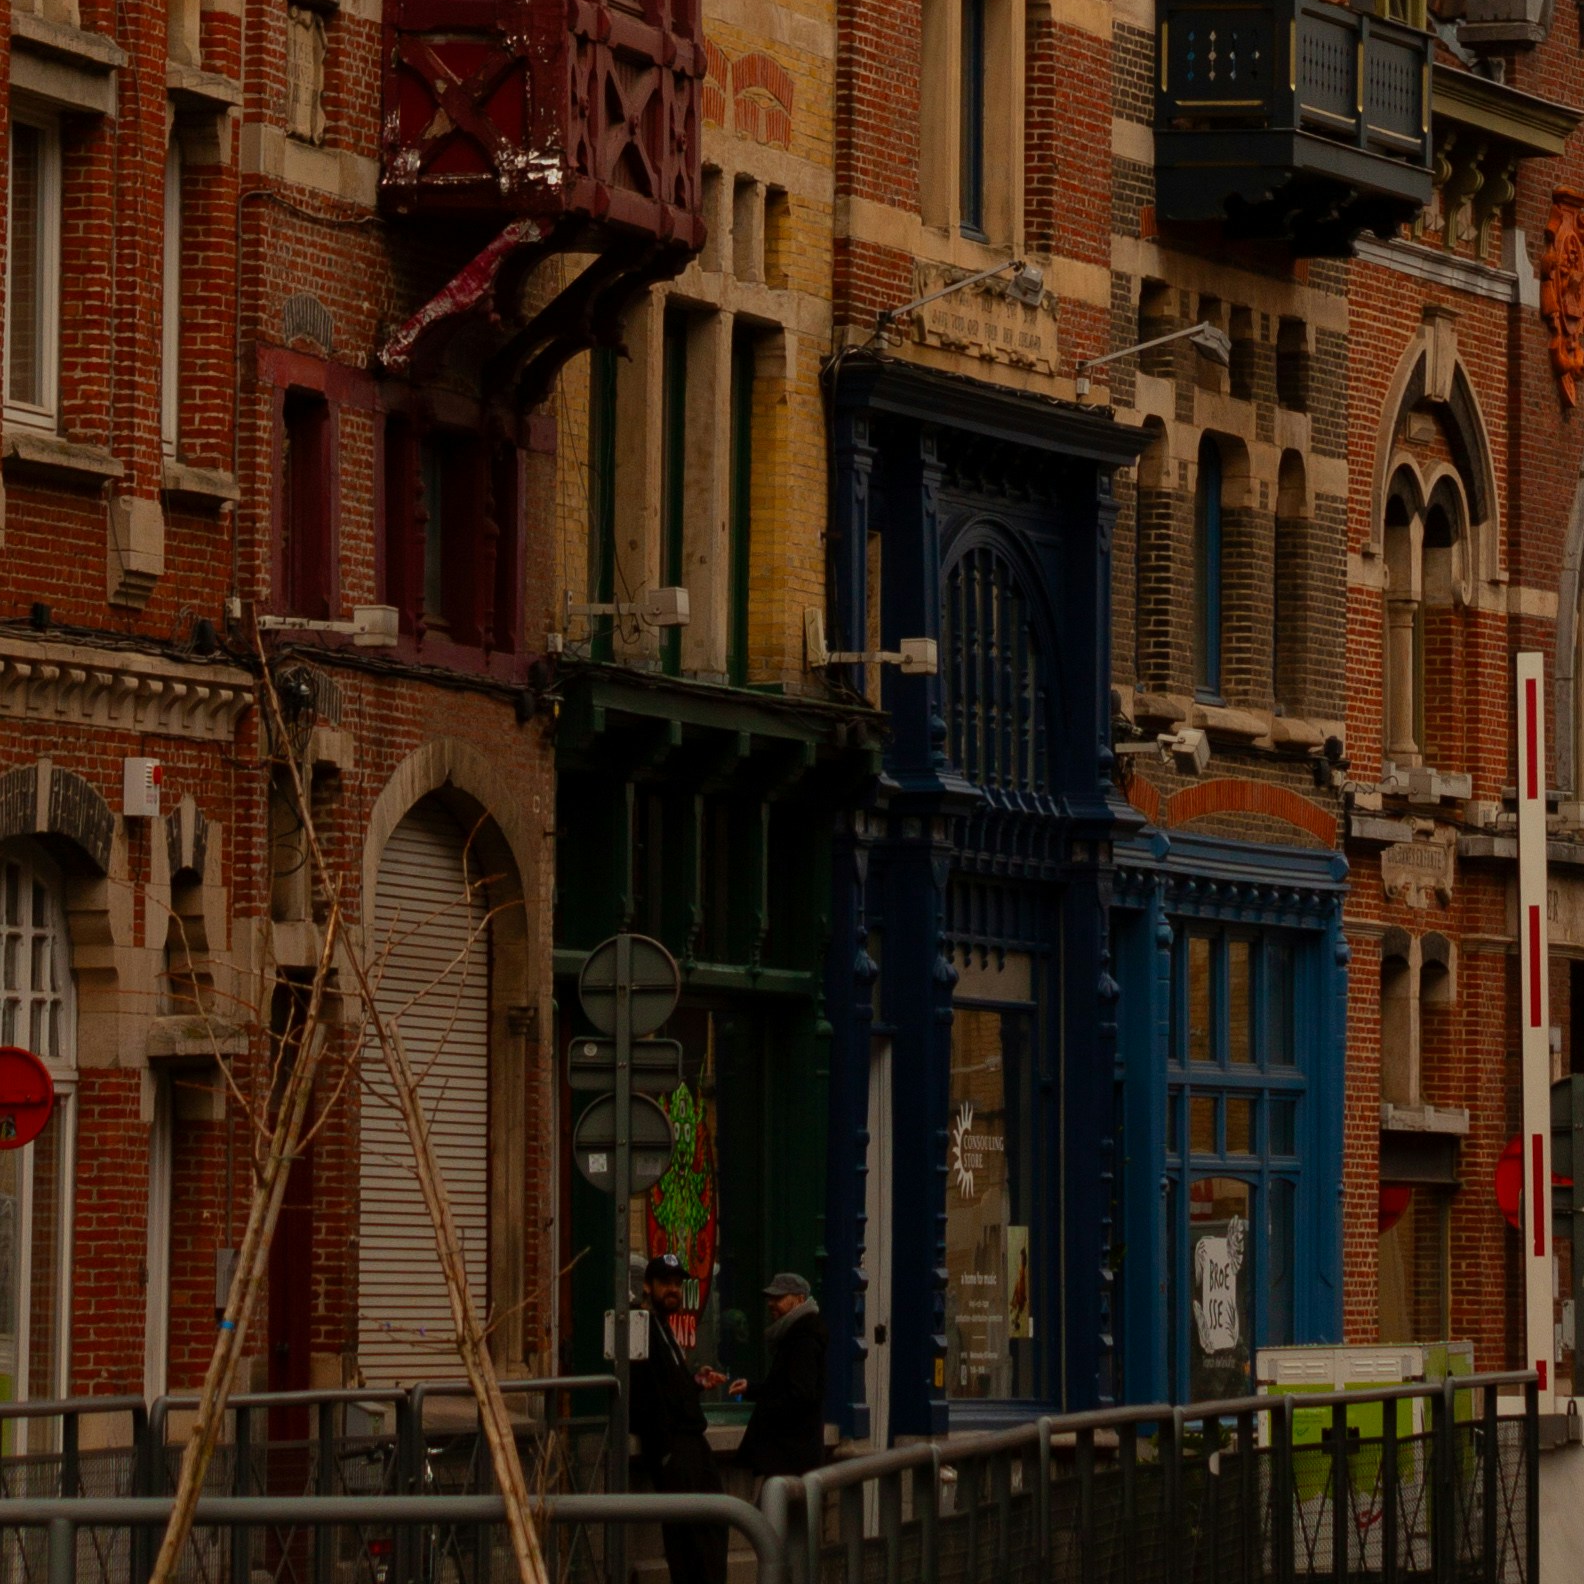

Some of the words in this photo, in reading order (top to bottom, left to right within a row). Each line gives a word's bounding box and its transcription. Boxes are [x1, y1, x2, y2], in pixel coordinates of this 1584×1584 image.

[963, 1135, 1004, 1151] CONSOULING
[964, 1153, 983, 1169] STORE
[1209, 1259, 1230, 1293] BROE
[1209, 1299, 1223, 1330] SSE
